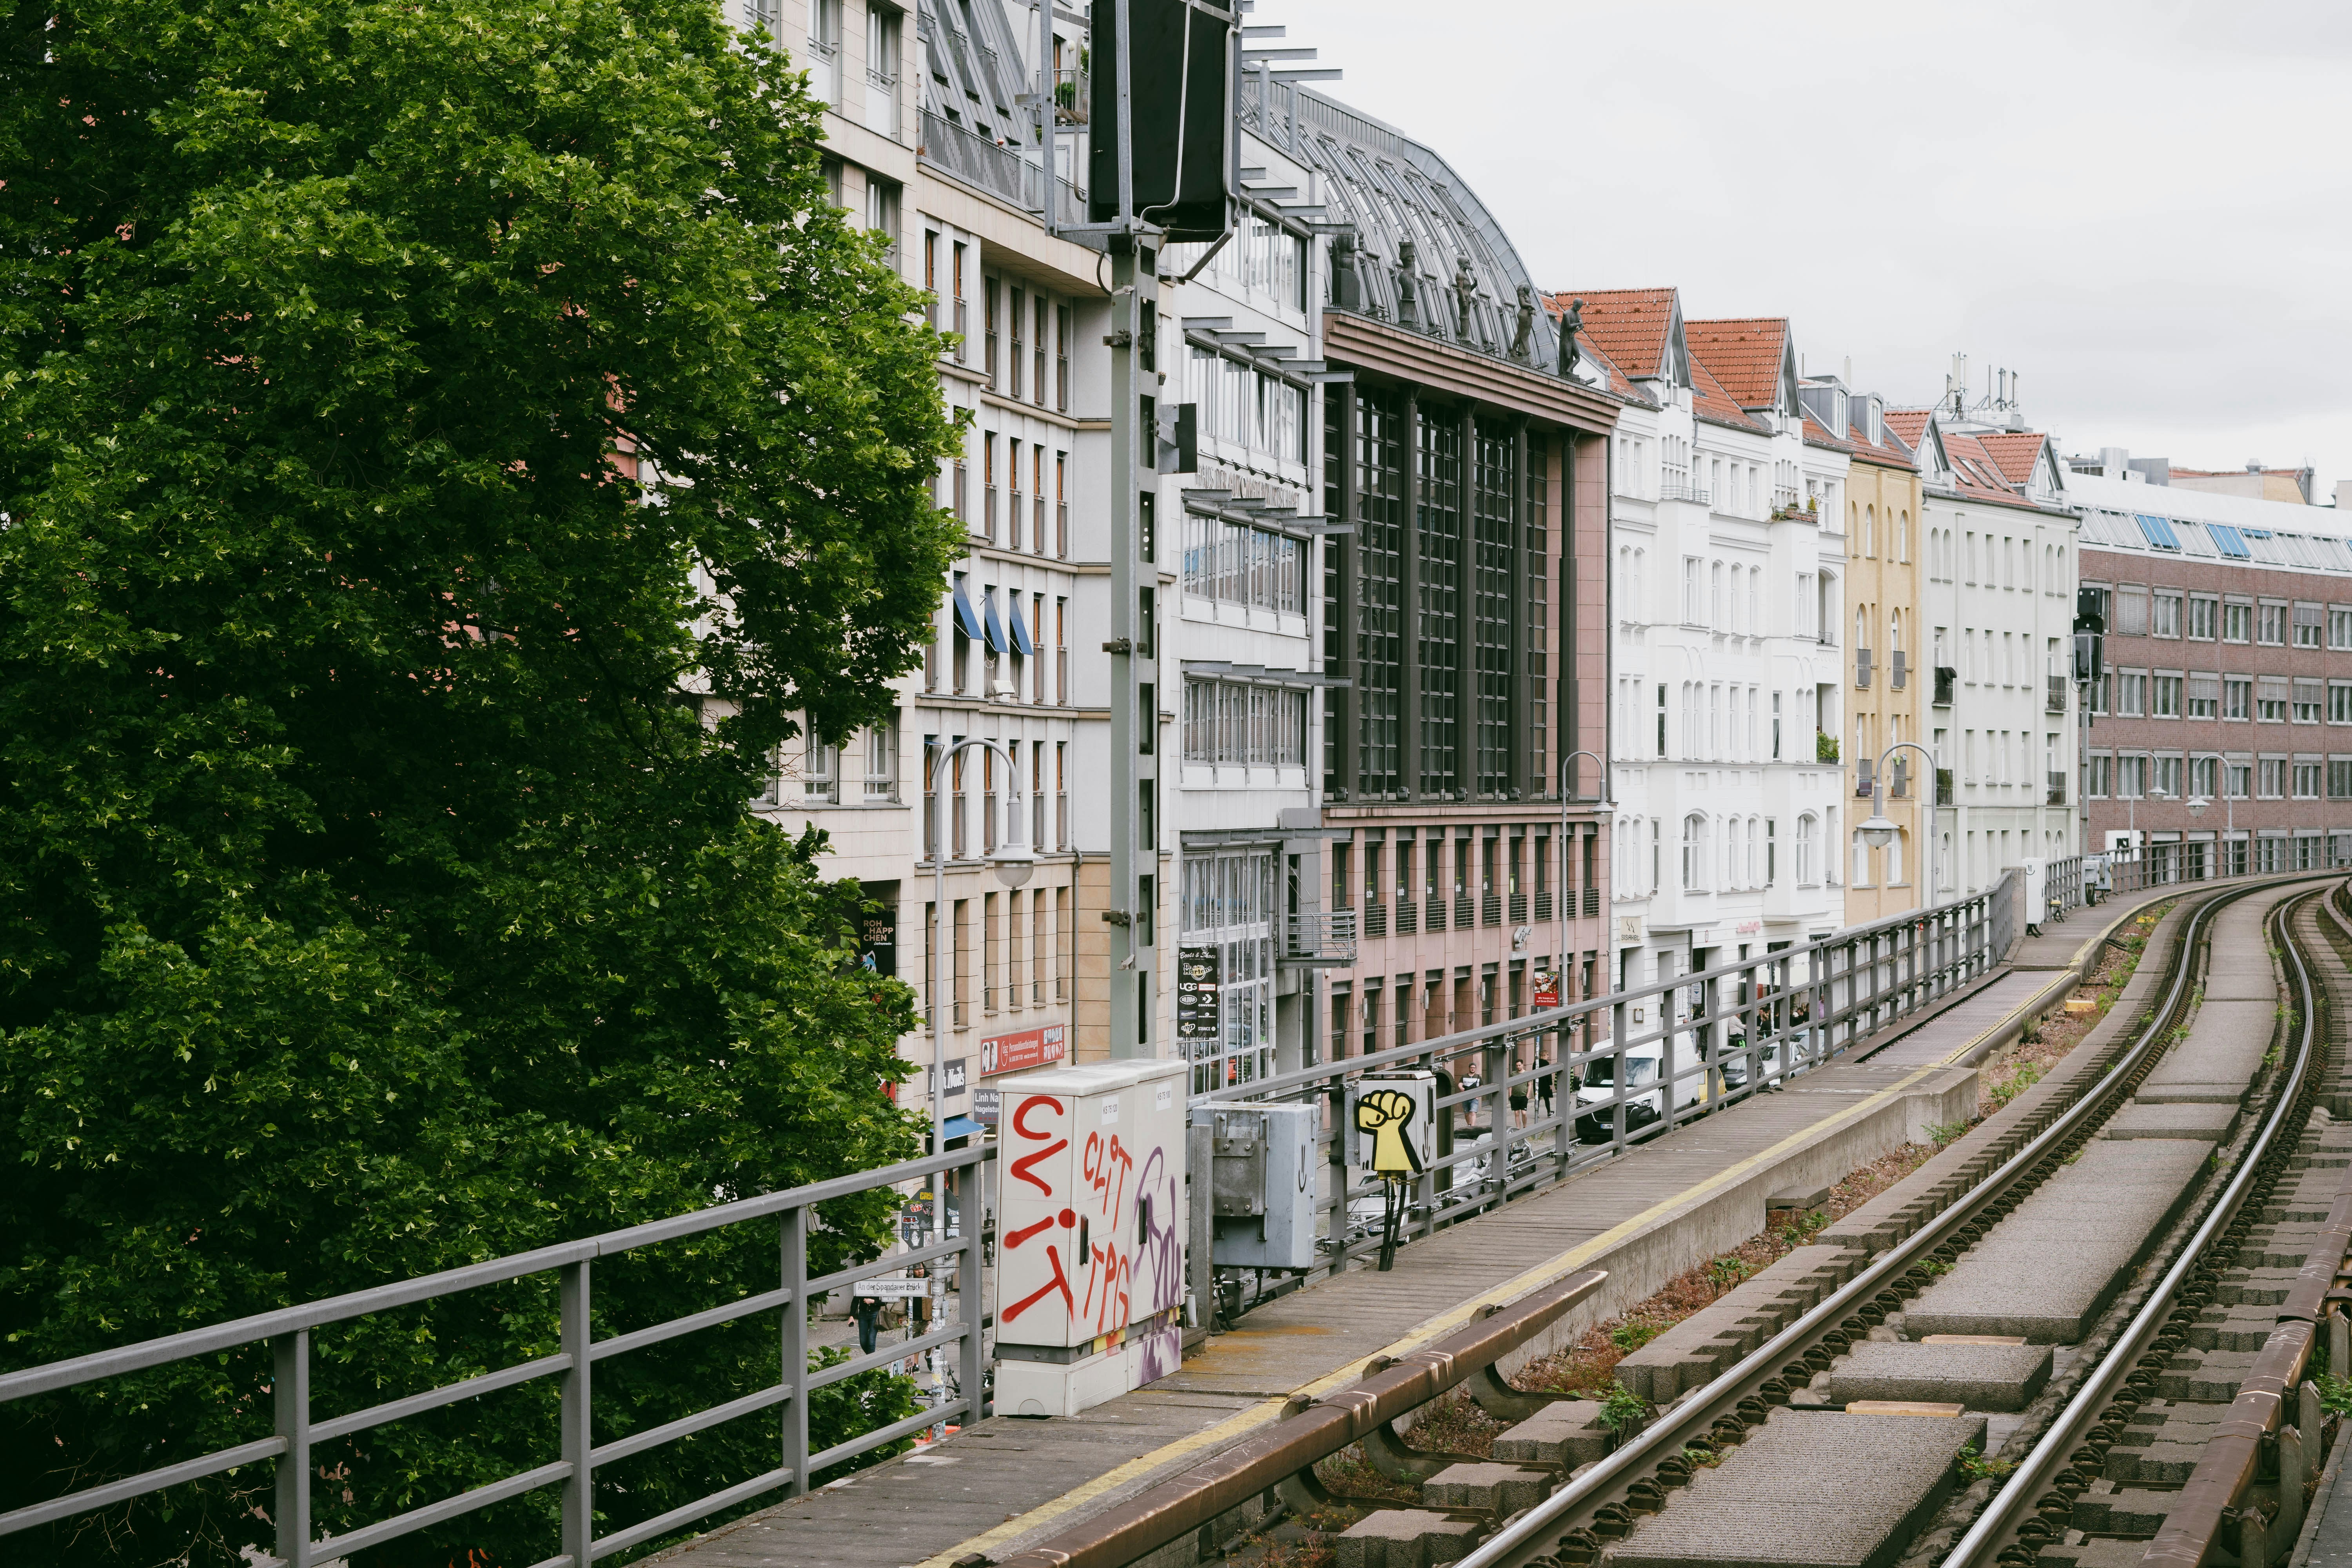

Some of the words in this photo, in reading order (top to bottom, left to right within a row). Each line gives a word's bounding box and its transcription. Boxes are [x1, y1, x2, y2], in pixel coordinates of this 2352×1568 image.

[1195, 463, 1214, 489] HAUS
[1214, 468, 1227, 489] DER
[1183, 966, 1213, 975] Martens
[1180, 983, 1197, 991] UGG
[947, 1066, 965, 1089] Nails
[975, 1093, 988, 1102] Linh
[1157, 1093, 1162, 1101] KS
[1103, 1105, 1107, 1114] KS
[1108, 1105, 1112, 1113] 75
[858, 1282, 865, 1290] An
[866, 1282, 875, 1290] der
[876, 1282, 905, 1292] Spandauer
